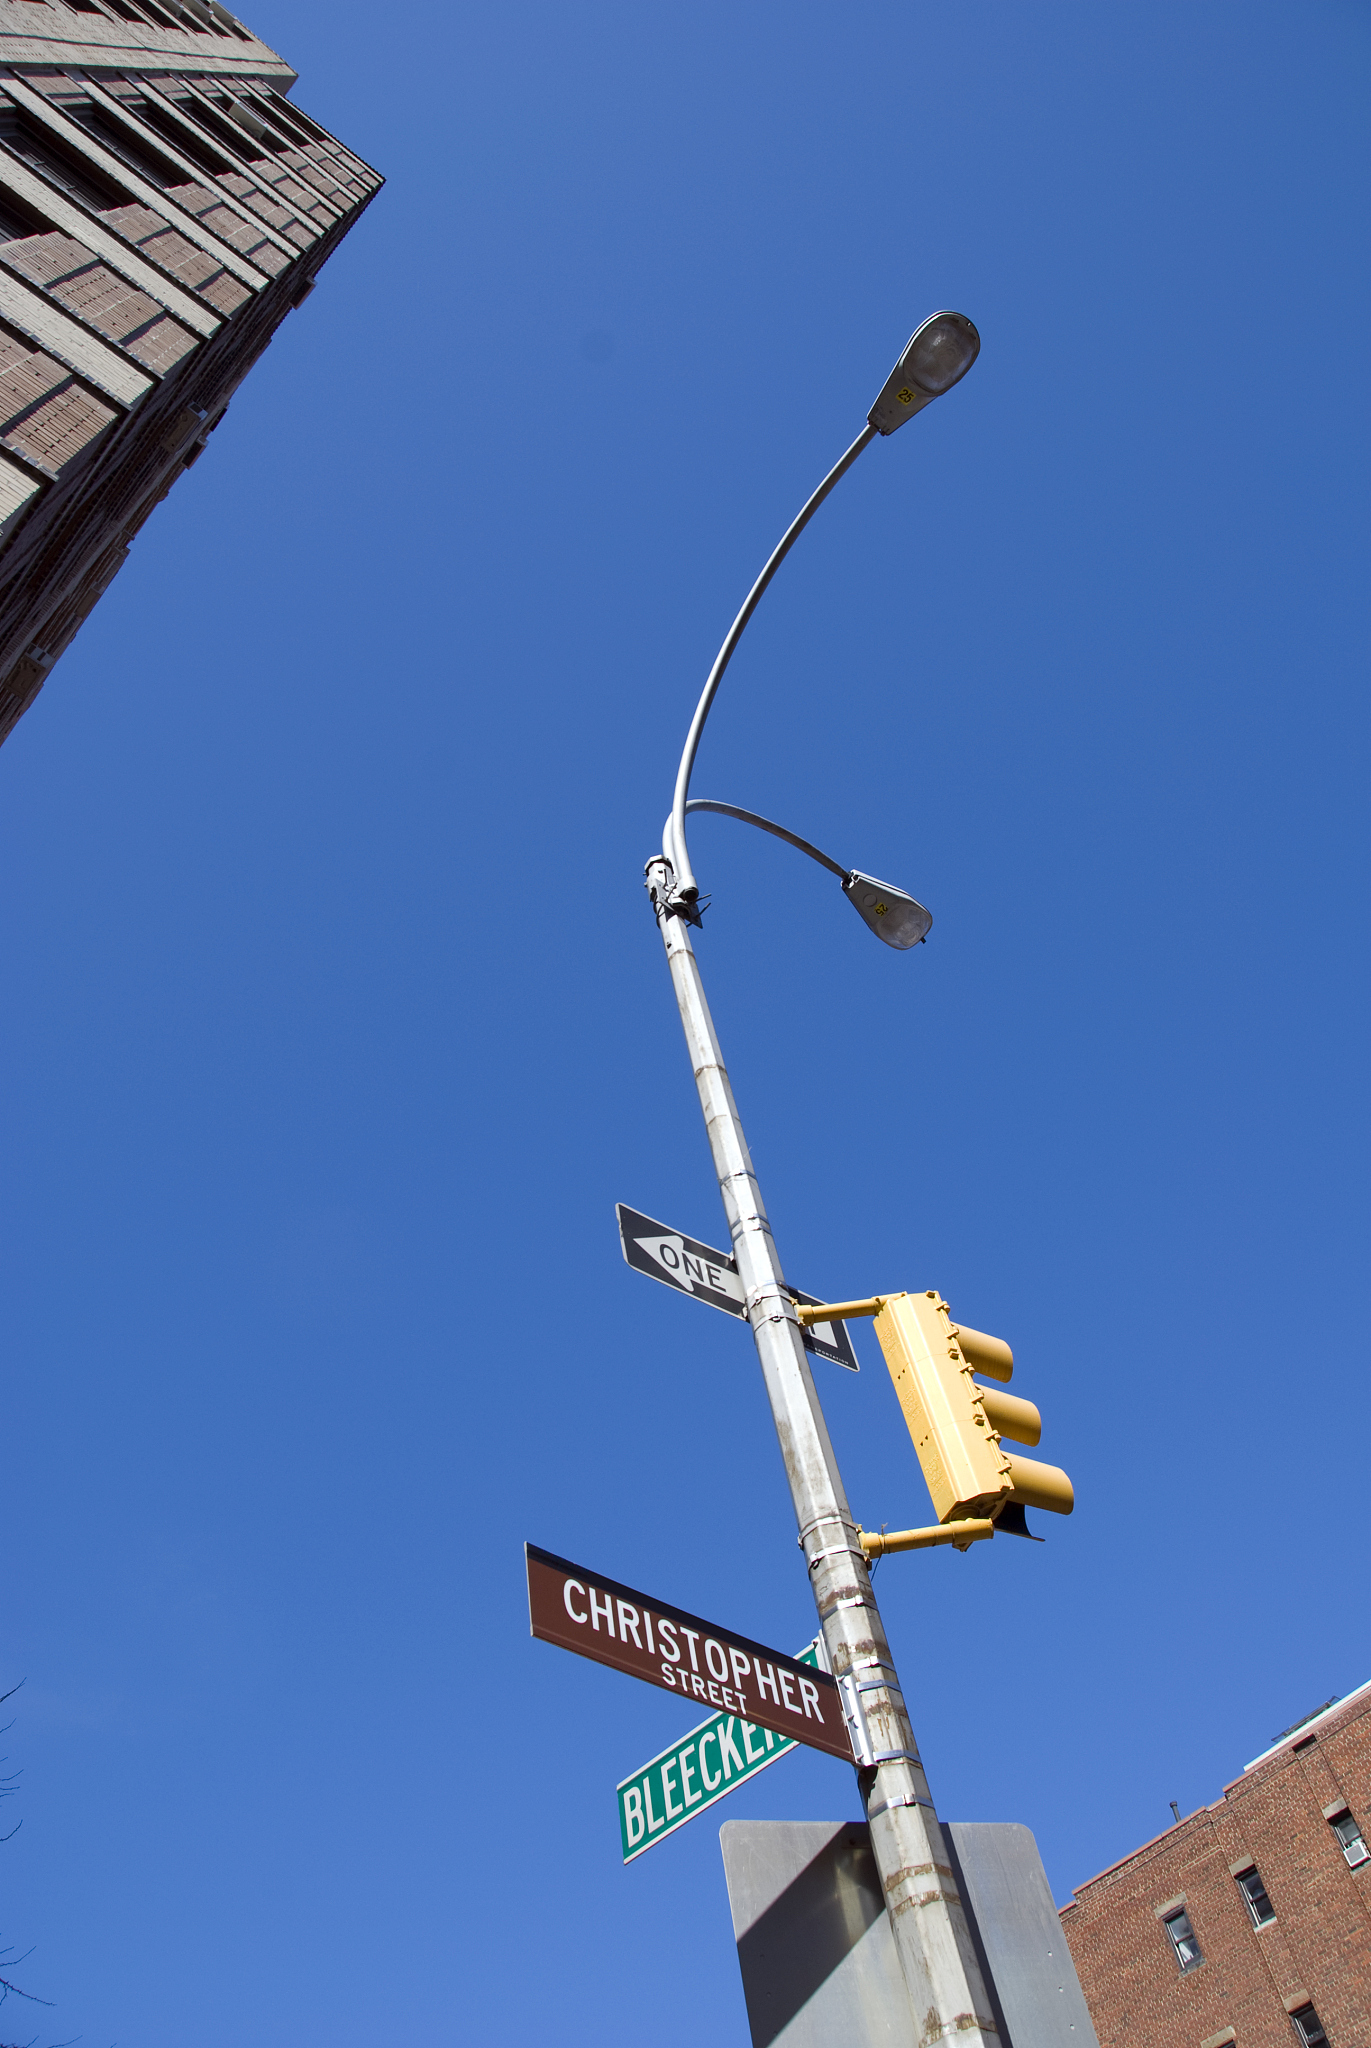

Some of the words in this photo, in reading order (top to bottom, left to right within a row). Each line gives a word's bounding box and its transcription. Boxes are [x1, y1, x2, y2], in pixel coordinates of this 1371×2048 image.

[898, 388, 914, 403] 25
[875, 903, 888, 916] 25
[659, 1243, 727, 1292] ONE
[563, 1578, 825, 1724] CHRISTOPHER
[660, 1662, 747, 1715] STREET
